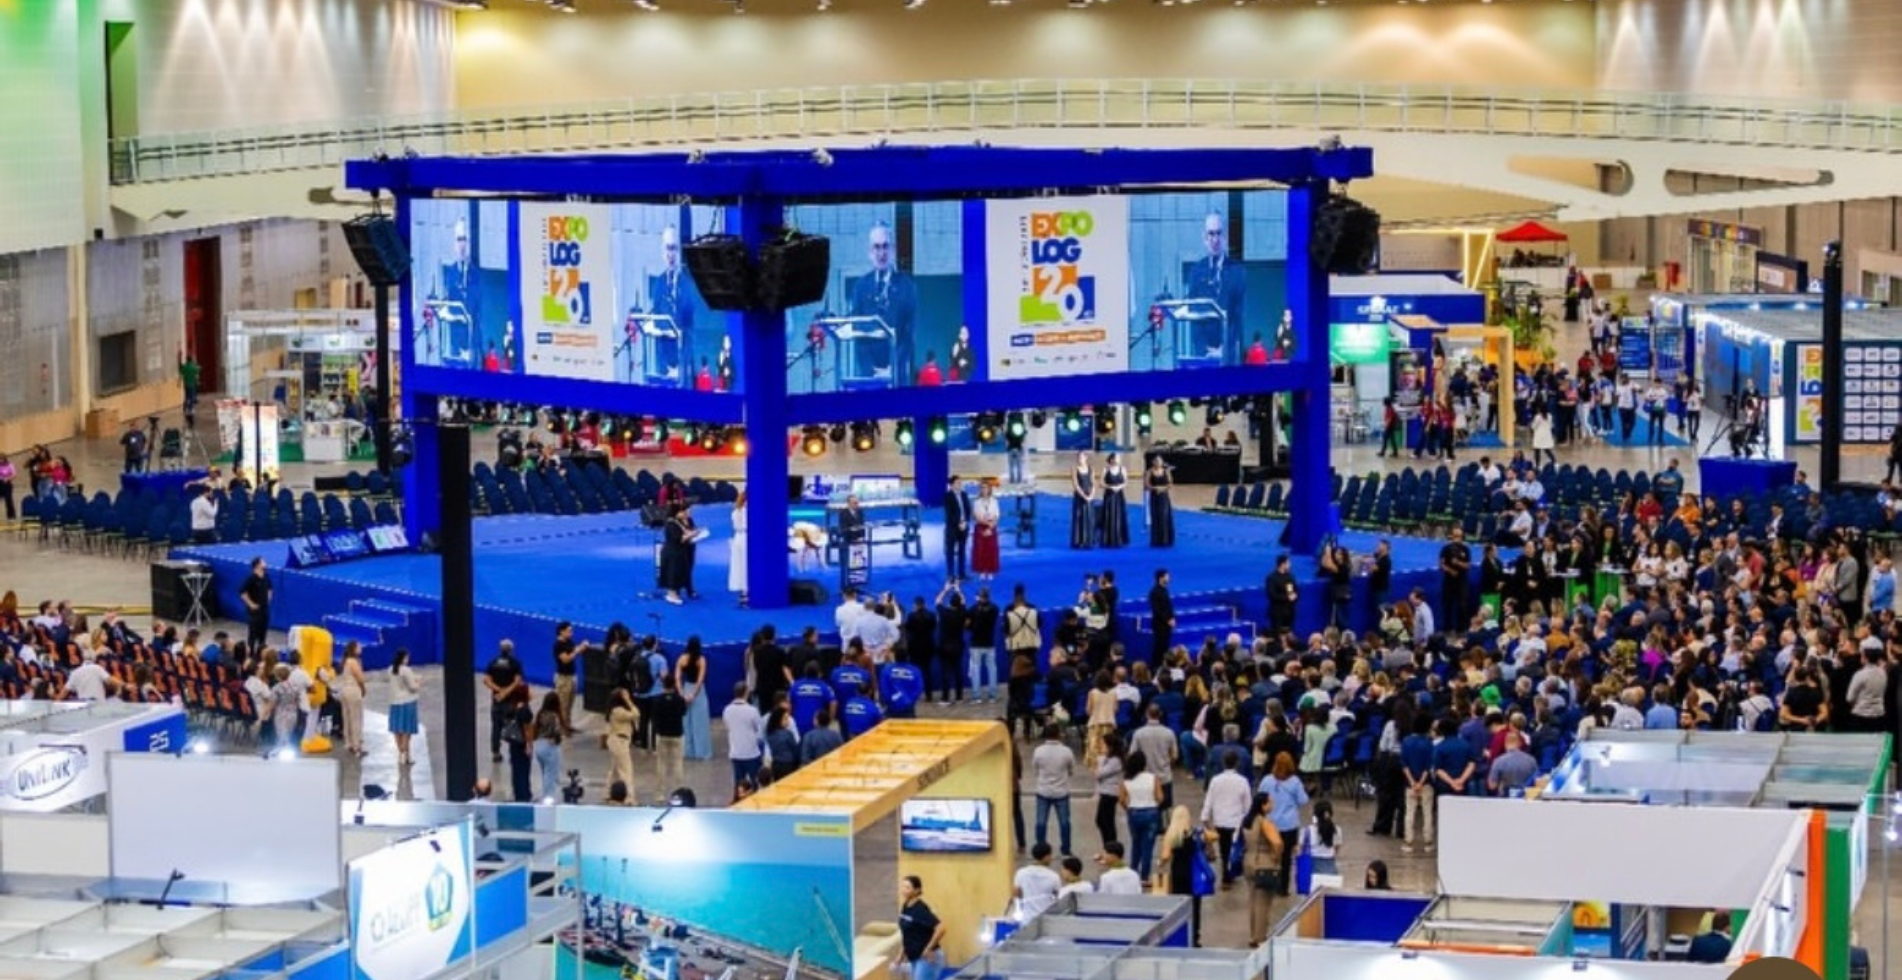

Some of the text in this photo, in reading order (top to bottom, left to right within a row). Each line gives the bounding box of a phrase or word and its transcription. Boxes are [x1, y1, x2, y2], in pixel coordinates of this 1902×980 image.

[548, 215, 589, 242] EXPO
[1031, 210, 1094, 238] EXPO
[549, 241, 581, 267] LOG
[1031, 237, 1082, 265] LOG
[1039, 265, 1085, 320] 20
